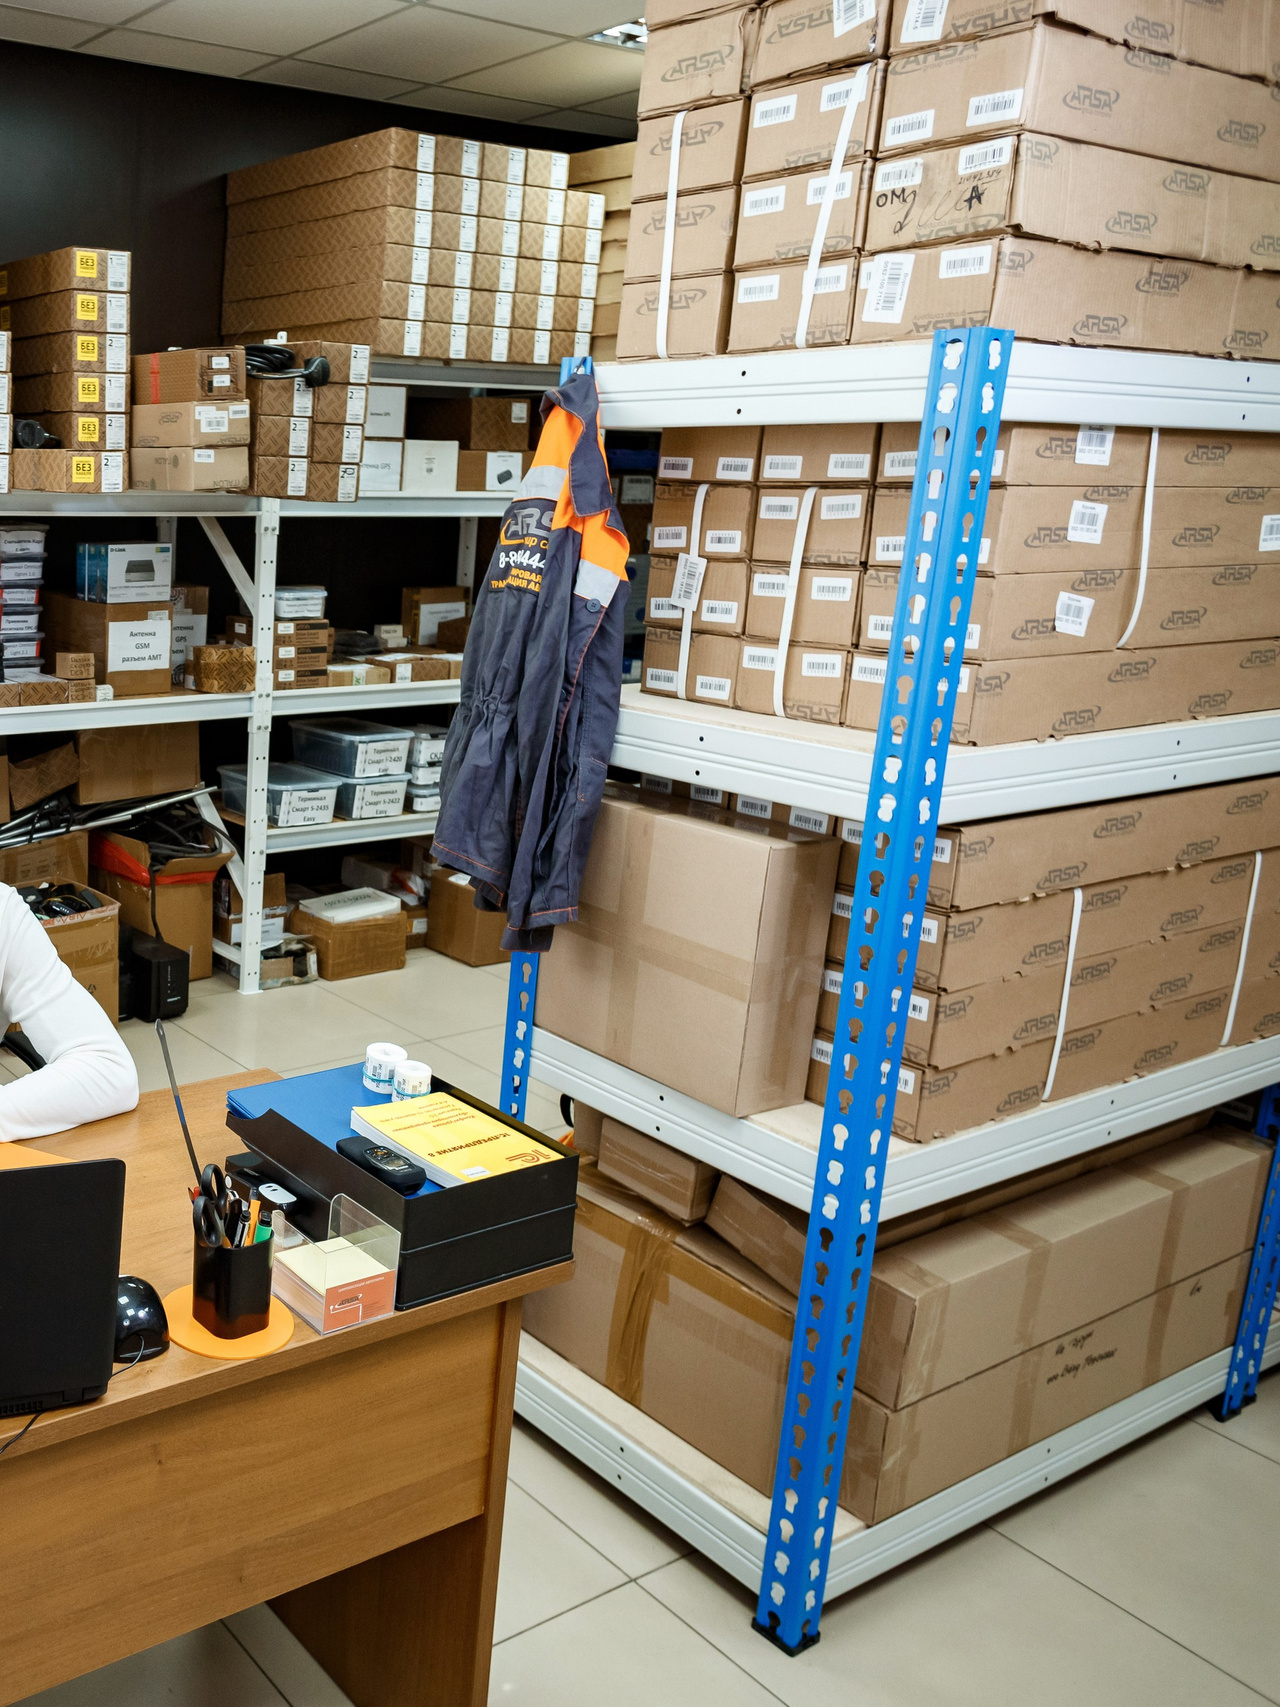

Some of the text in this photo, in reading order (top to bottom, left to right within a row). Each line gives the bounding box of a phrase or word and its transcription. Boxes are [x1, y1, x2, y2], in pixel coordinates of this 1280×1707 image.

[672, 51, 726, 78] ARSA
[80, 258, 95, 266] БЕЗ
[80, 301, 96, 310] БЕЗ
[352, 350, 359, 358] 2
[291, 423, 298, 431] 2
[103, 458, 110, 466] 2
[438, 1132, 510, 1155] 1С:ПРЕДПРИЯТИЕ
